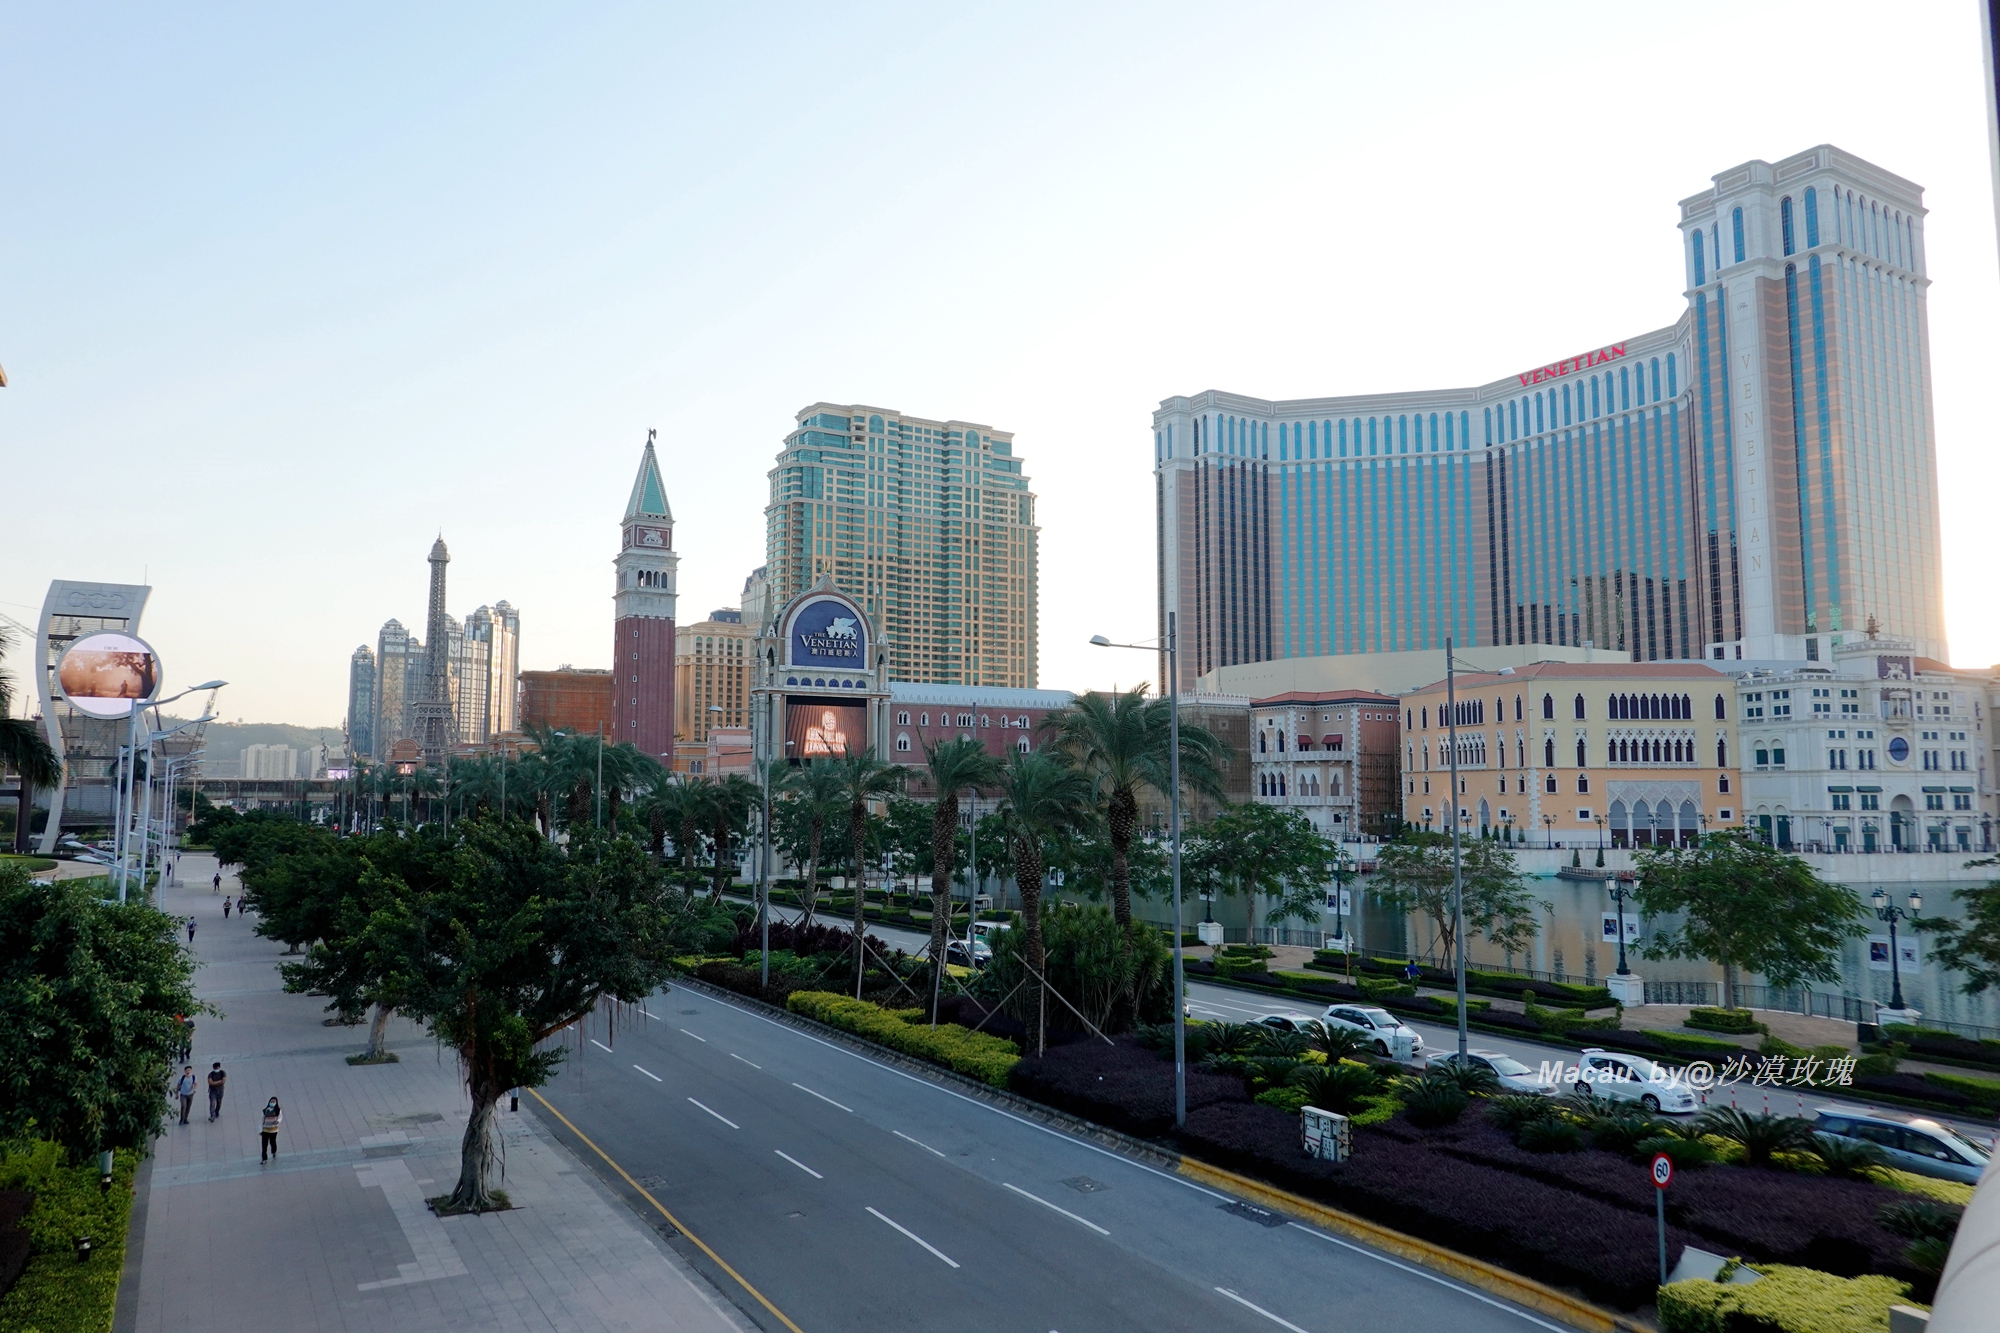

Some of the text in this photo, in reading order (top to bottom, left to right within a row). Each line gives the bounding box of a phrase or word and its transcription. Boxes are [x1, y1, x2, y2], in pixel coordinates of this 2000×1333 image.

[1518, 342, 1626, 387] VENETIAN
[1741, 354, 1762, 573] VENETIAN
[1656, 1162, 1668, 1178] 60
